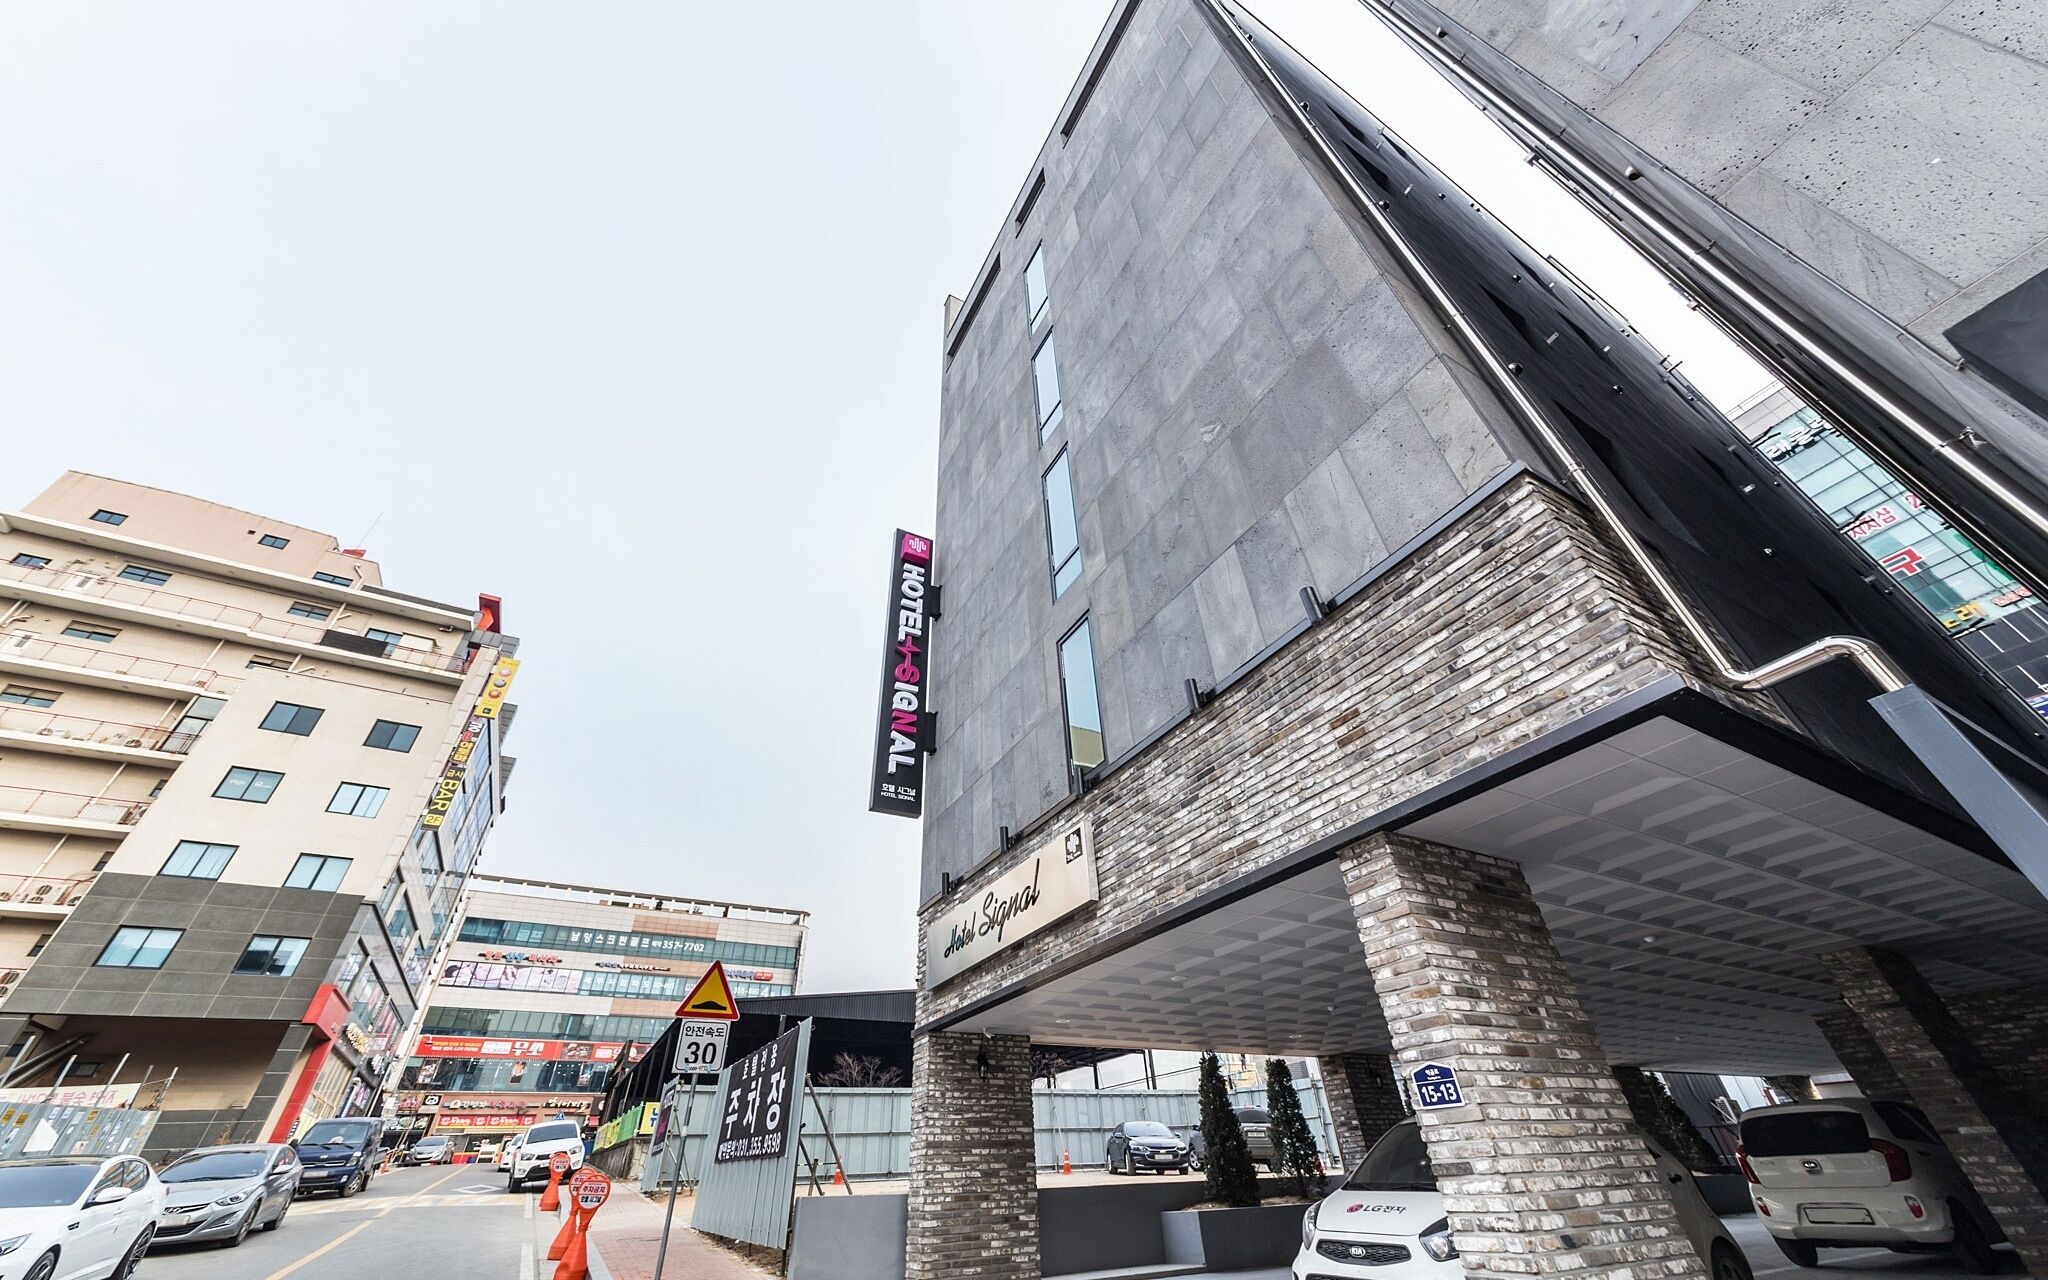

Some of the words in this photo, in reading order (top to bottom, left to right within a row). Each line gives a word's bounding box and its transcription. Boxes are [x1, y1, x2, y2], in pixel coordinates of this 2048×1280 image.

[897, 562, 925, 642] HOTEL
[887, 661, 921, 775] SIGNAL
[430, 779, 460, 811] BAR
[880, 791, 897, 799] HOTEL
[898, 794, 916, 802] SIGNAL
[881, 782, 896, 792] 호텔
[897, 785, 916, 797] 시그널
[426, 815, 441, 825] 2F
[944, 911, 976, 958] Hotel
[978, 857, 1041, 943] Signal
[661, 940, 705, 952] 357-7702
[684, 1025, 725, 1038] 안전속도
[684, 1041, 717, 1065] 30
[725, 1066, 787, 1139] 주차장
[1421, 1082, 1457, 1103] 15-13
[582, 1185, 606, 1194] 주차금지
